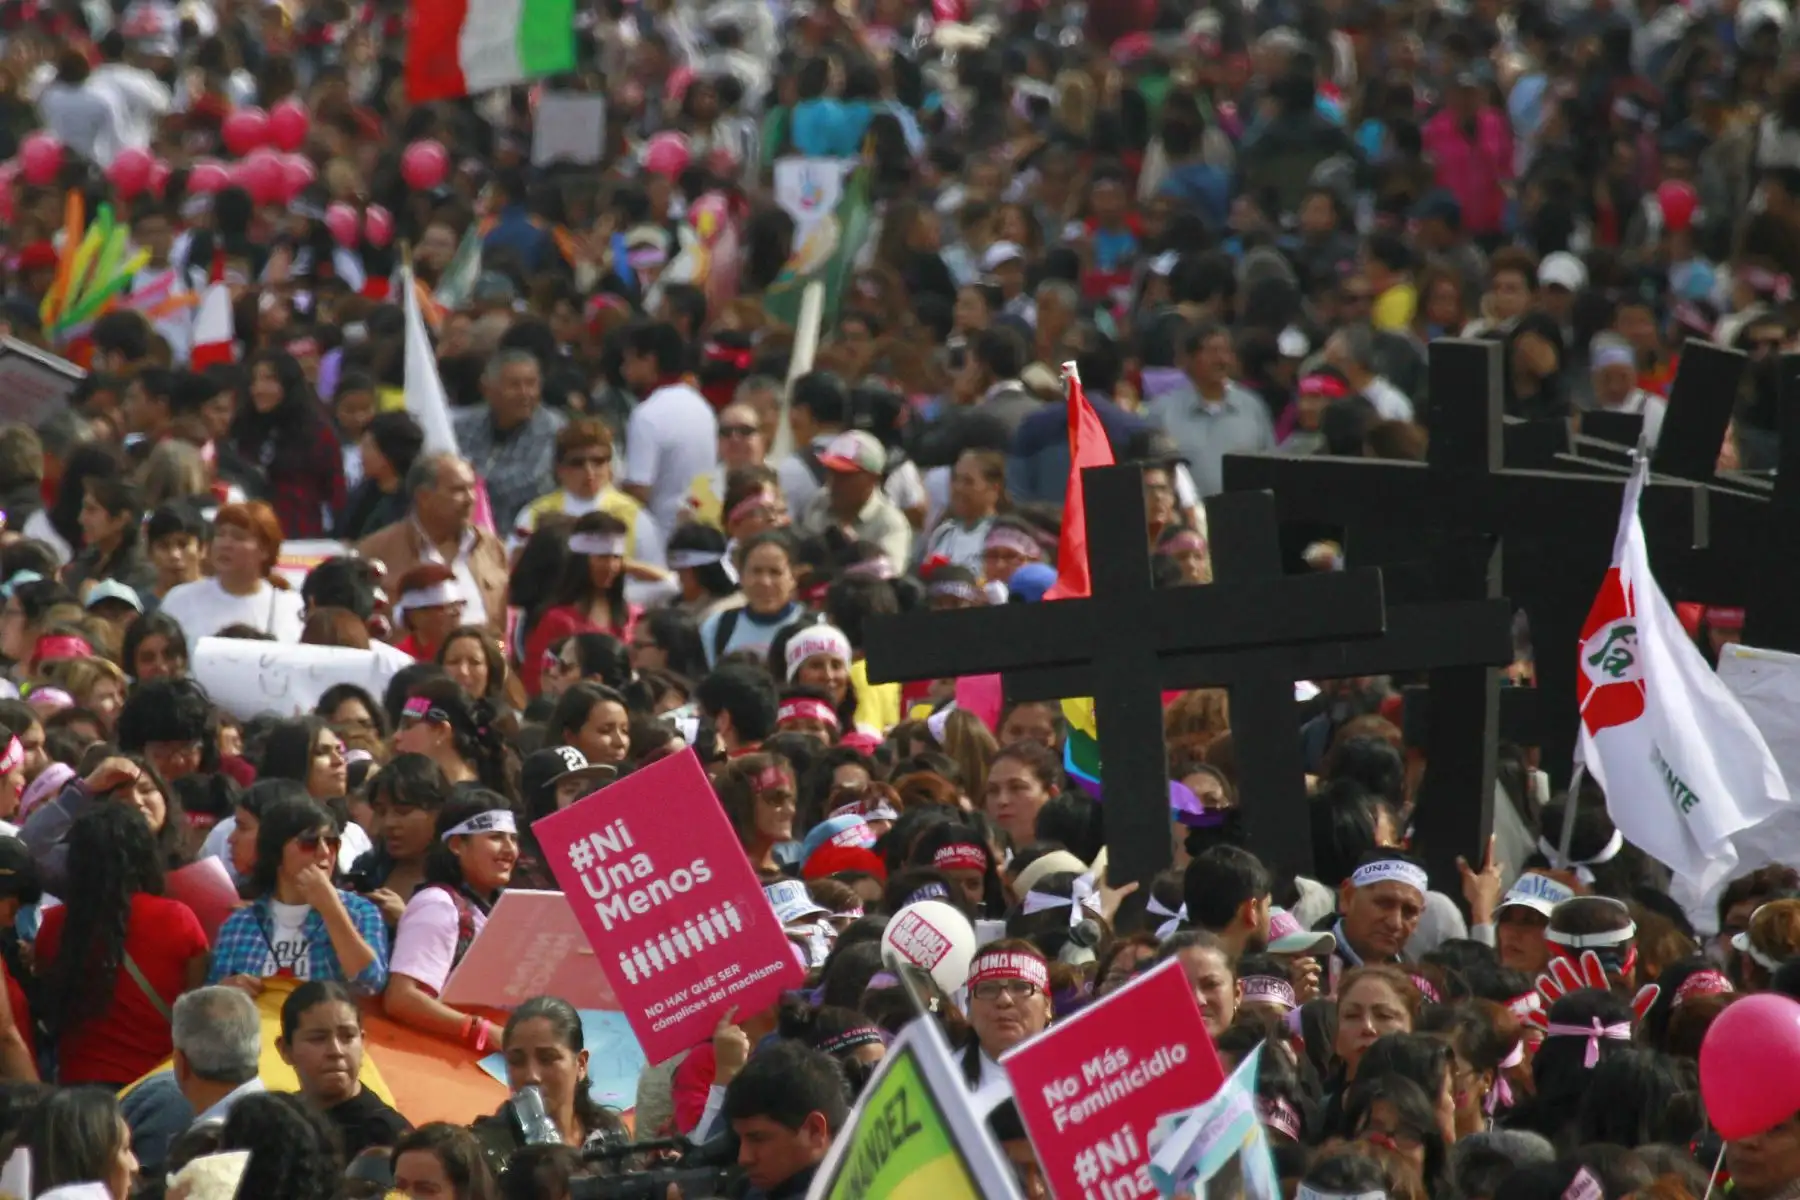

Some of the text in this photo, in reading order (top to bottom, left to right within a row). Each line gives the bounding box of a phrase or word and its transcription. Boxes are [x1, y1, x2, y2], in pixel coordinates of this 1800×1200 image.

[568, 818, 634, 872] #Ni
[580, 853, 654, 899] Una
[594, 858, 712, 931] Menos
[708, 988, 727, 1004] del
[728, 960, 784, 994] machismo
[981, 953, 1009, 970] UNA
[644, 963, 741, 1019] NO HAY QUE SER
[1042, 1047, 1130, 1109] No Más
[1052, 1043, 1187, 1133] Feminicidio
[1073, 1122, 1140, 1188] #Ni
